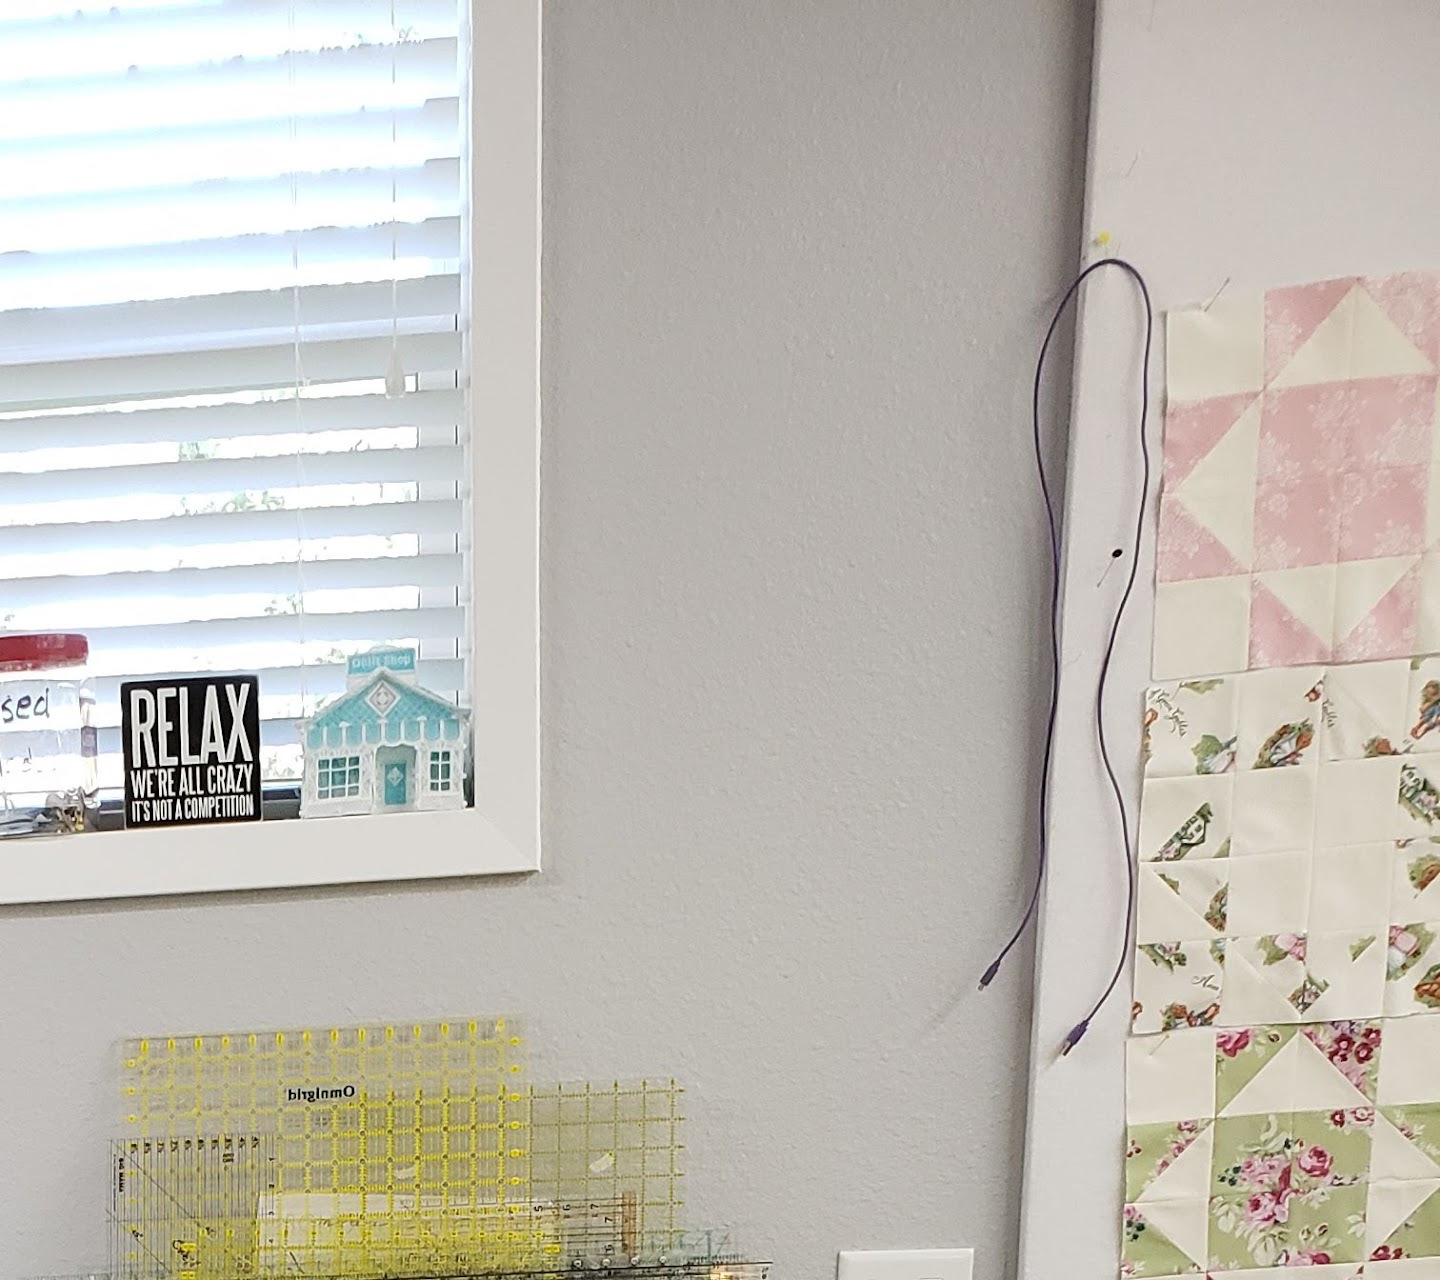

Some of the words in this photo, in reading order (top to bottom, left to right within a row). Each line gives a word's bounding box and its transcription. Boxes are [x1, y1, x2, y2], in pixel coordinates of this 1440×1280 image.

[130, 683, 253, 768] RELAX
[130, 768, 176, 798] WE'RE
[179, 766, 205, 796] ALL
[207, 763, 253, 794] CRAZY
[131, 800, 151, 822] IT'S
[152, 799, 173, 821] NOT
[175, 798, 183, 820] A
[184, 794, 254, 819] COMPETITION
